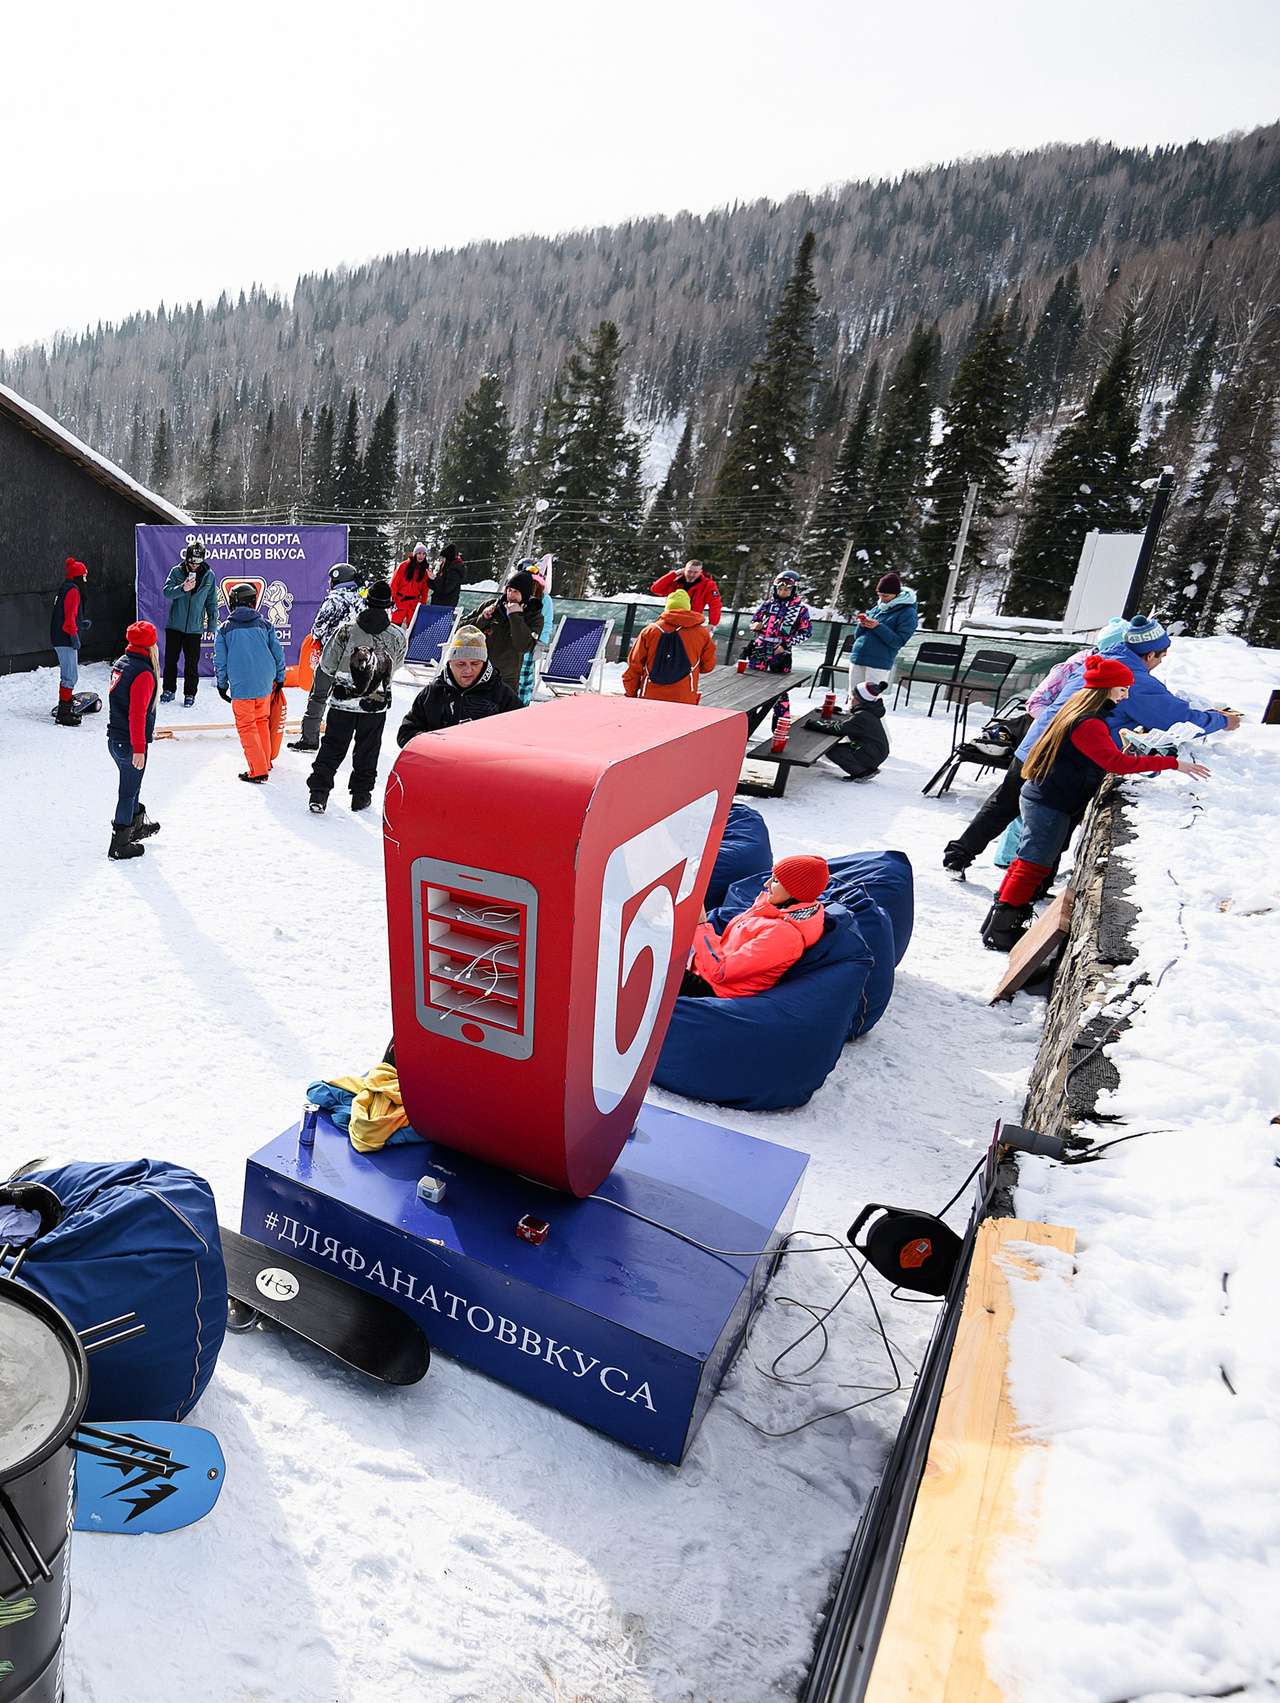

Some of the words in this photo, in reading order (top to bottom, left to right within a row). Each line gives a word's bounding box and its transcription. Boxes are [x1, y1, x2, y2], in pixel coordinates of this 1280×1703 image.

[185, 533, 247, 545] ФАНАТАМ
[251, 533, 300, 545] СПОРТА
[265, 548, 305, 560] ВКУСА
[264, 1211, 657, 1413] #ДЛЯФАНАТОВВКУСА
